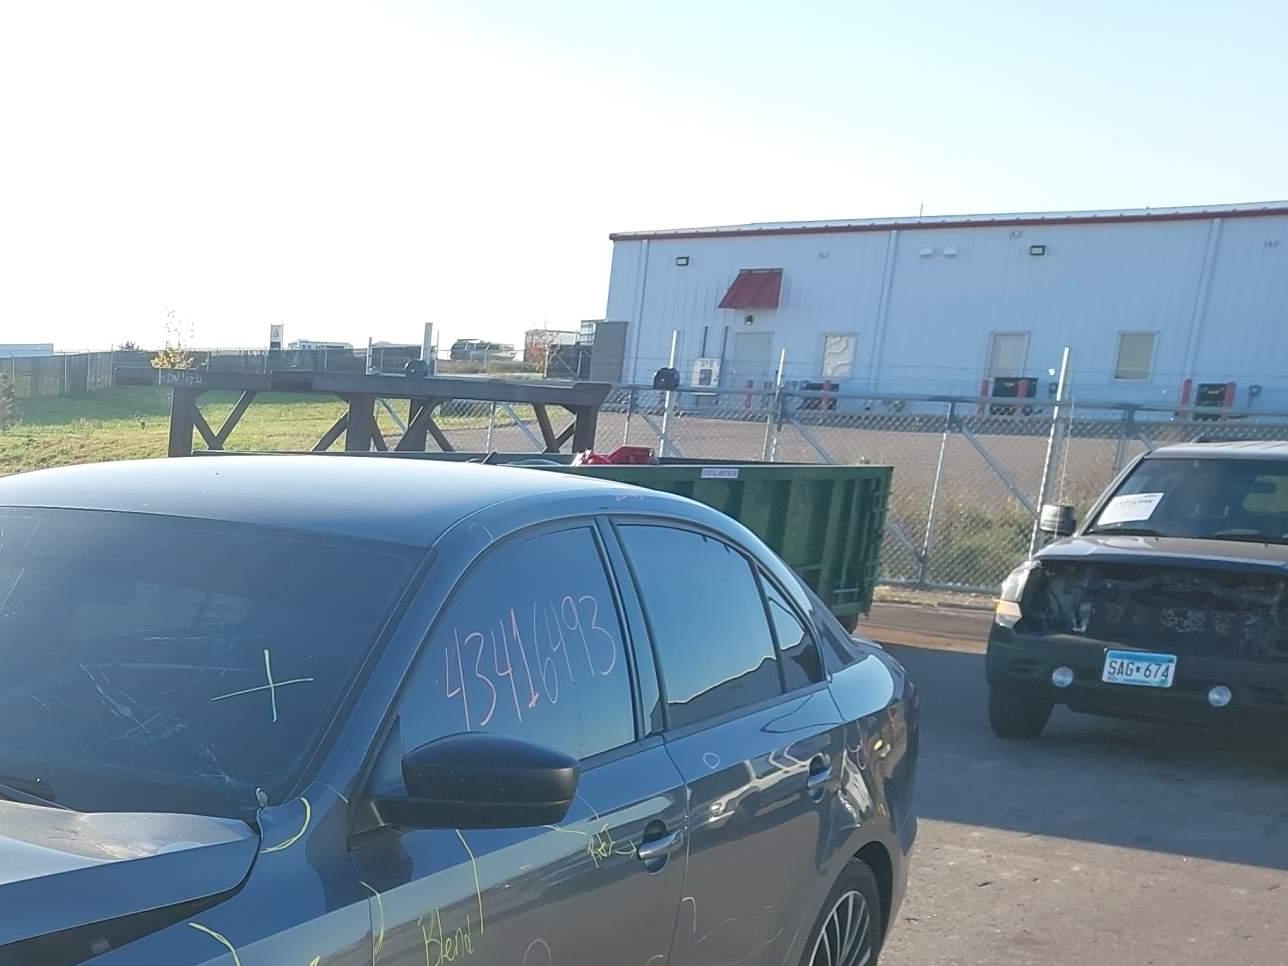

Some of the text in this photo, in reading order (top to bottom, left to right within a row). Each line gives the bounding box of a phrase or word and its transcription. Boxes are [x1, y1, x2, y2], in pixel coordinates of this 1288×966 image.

[445, 595, 616, 732] 43416493
[1108, 660, 1170, 680] SAG 674
